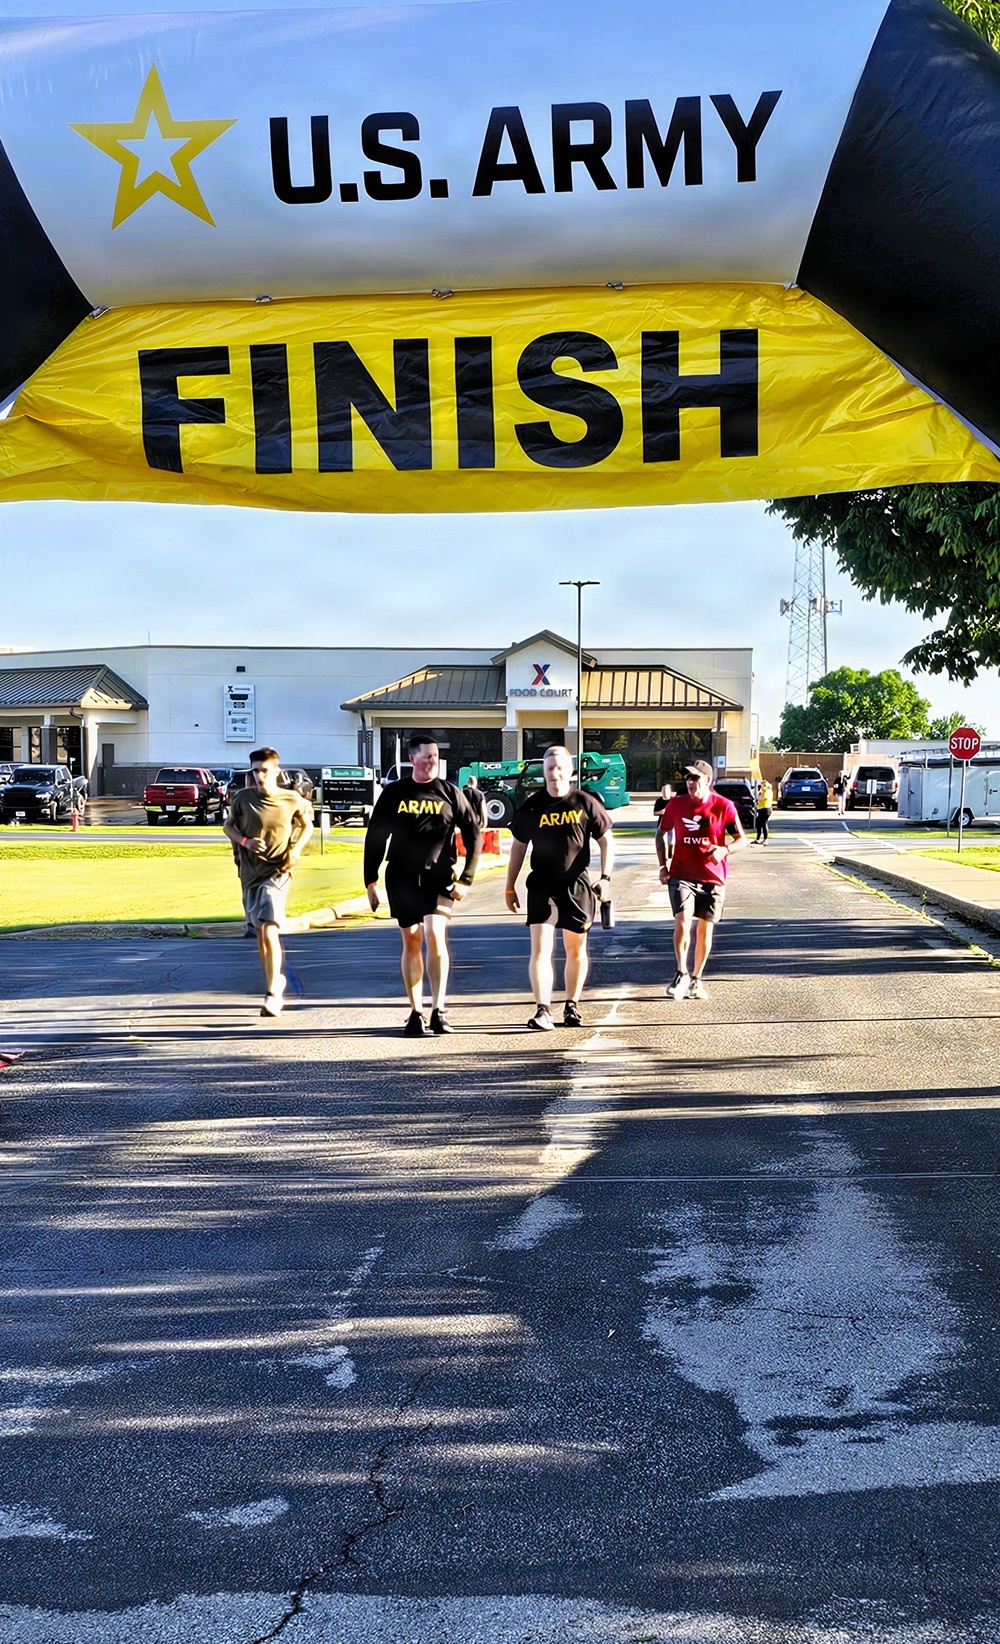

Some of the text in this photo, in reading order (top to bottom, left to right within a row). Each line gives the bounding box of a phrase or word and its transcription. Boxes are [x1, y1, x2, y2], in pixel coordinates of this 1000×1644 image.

[268, 89, 783, 205] U.S. ARMY
[138, 329, 760, 474] FINISH
[509, 688, 572, 697] FOOD COURT
[951, 737, 979, 750] STOP
[397, 800, 445, 814] ARMY
[539, 809, 583, 828] ARMY
